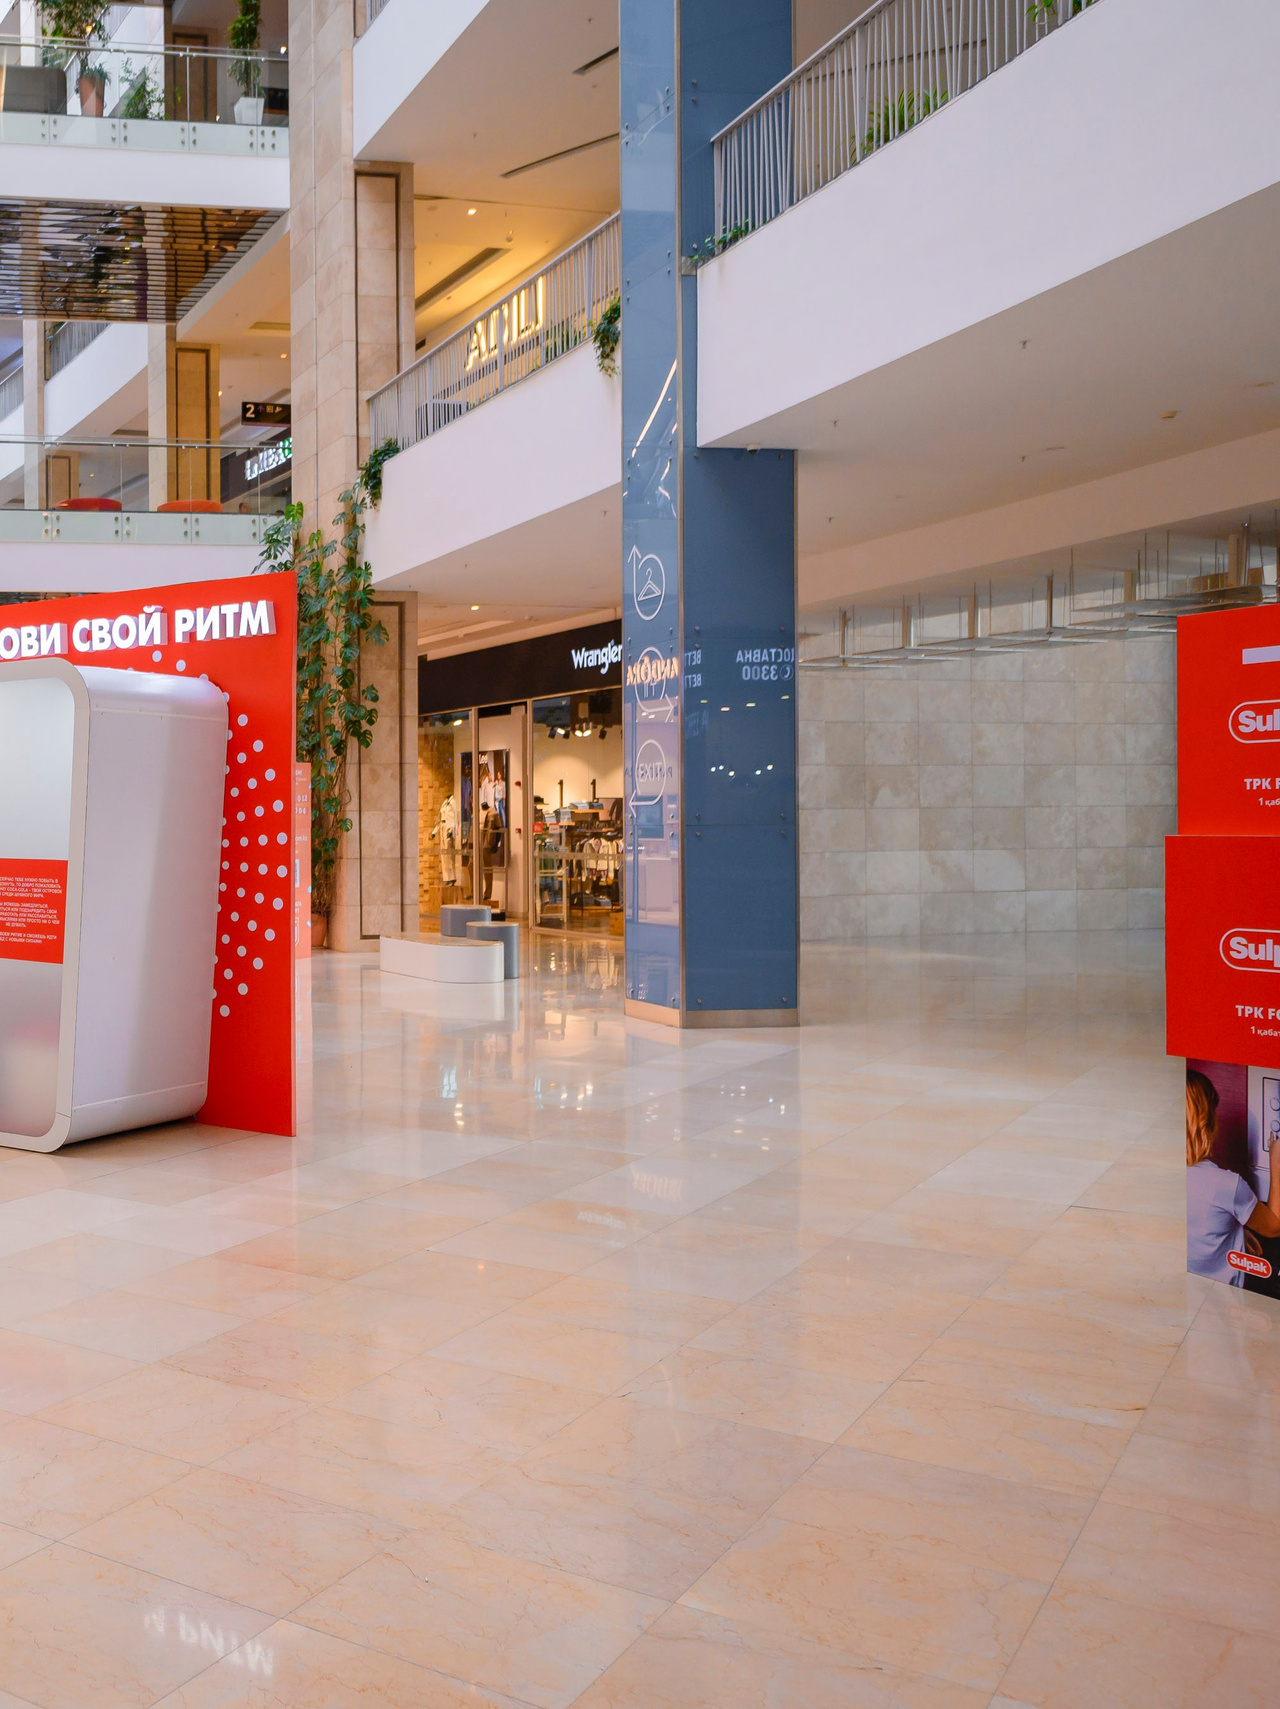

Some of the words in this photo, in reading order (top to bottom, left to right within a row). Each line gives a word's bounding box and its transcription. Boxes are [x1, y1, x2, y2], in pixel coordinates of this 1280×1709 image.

[245, 403, 256, 418] 2
[72, 605, 168, 652] СВОЙ
[175, 600, 274, 643] РИТМ
[571, 640, 622, 674] Wrangler
[639, 762, 662, 783] EXIT
[1230, 1253, 1268, 1274] Sulpak
